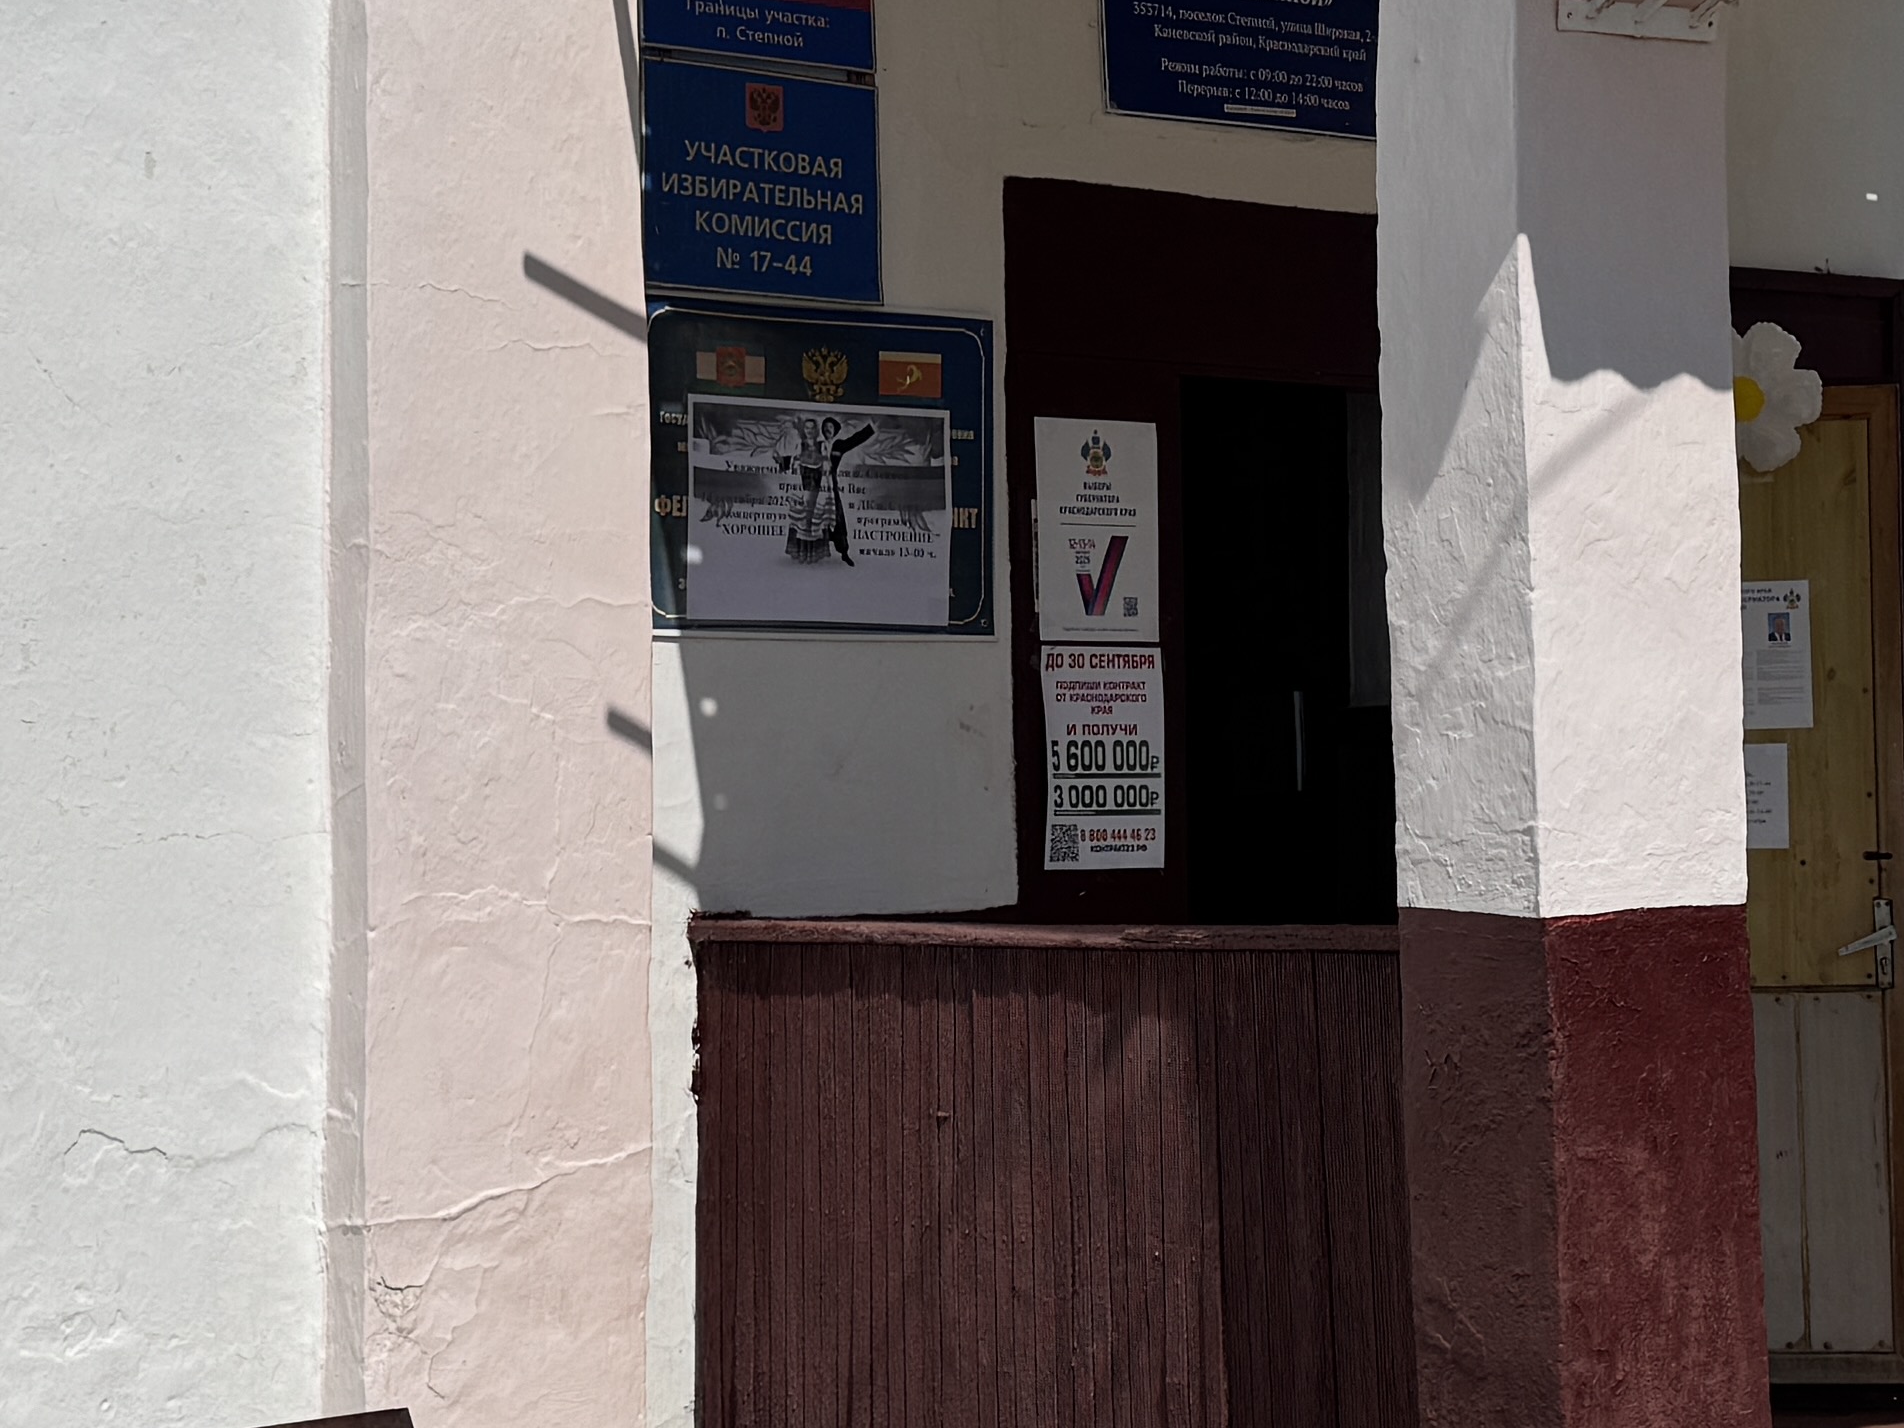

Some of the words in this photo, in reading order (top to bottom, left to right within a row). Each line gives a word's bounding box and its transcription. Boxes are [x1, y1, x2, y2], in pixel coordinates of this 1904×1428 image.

[765, 9, 830, 28] участка:
[716, 26, 730, 39] п.
[736, 26, 804, 48] Степной
[684, 139, 843, 179] УЧАСТКОВАЯ
[661, 172, 864, 215] ИЗБИРАТЕЛЬНАЯ
[696, 210, 832, 245] КОМИССИЯ
[717, 247, 740, 269] №
[750, 250, 812, 277] 17-44
[1045, 652, 1064, 671] ДО
[1068, 653, 1085, 669] 30
[1089, 653, 1155, 669] СЕНТЯБРЯ
[1056, 681, 1101, 691] ПОДПИШИ
[1103, 681, 1146, 690] КОНТРАКТ
[1056, 693, 1066, 702] ОТ
[1069, 693, 1147, 704] КРАСНОДАРСКОГО
[1091, 706, 1113, 715] КРАЯ
[1066, 724, 1077, 736] И
[1082, 724, 1138, 736] ПОЛУЧИ
[1051, 740, 1060, 771] 5
[1066, 740, 1106, 771] 600
[1054, 785, 1063, 808] 3
[1068, 785, 1107, 808] 000
[1144, 828, 1156, 841] 23
